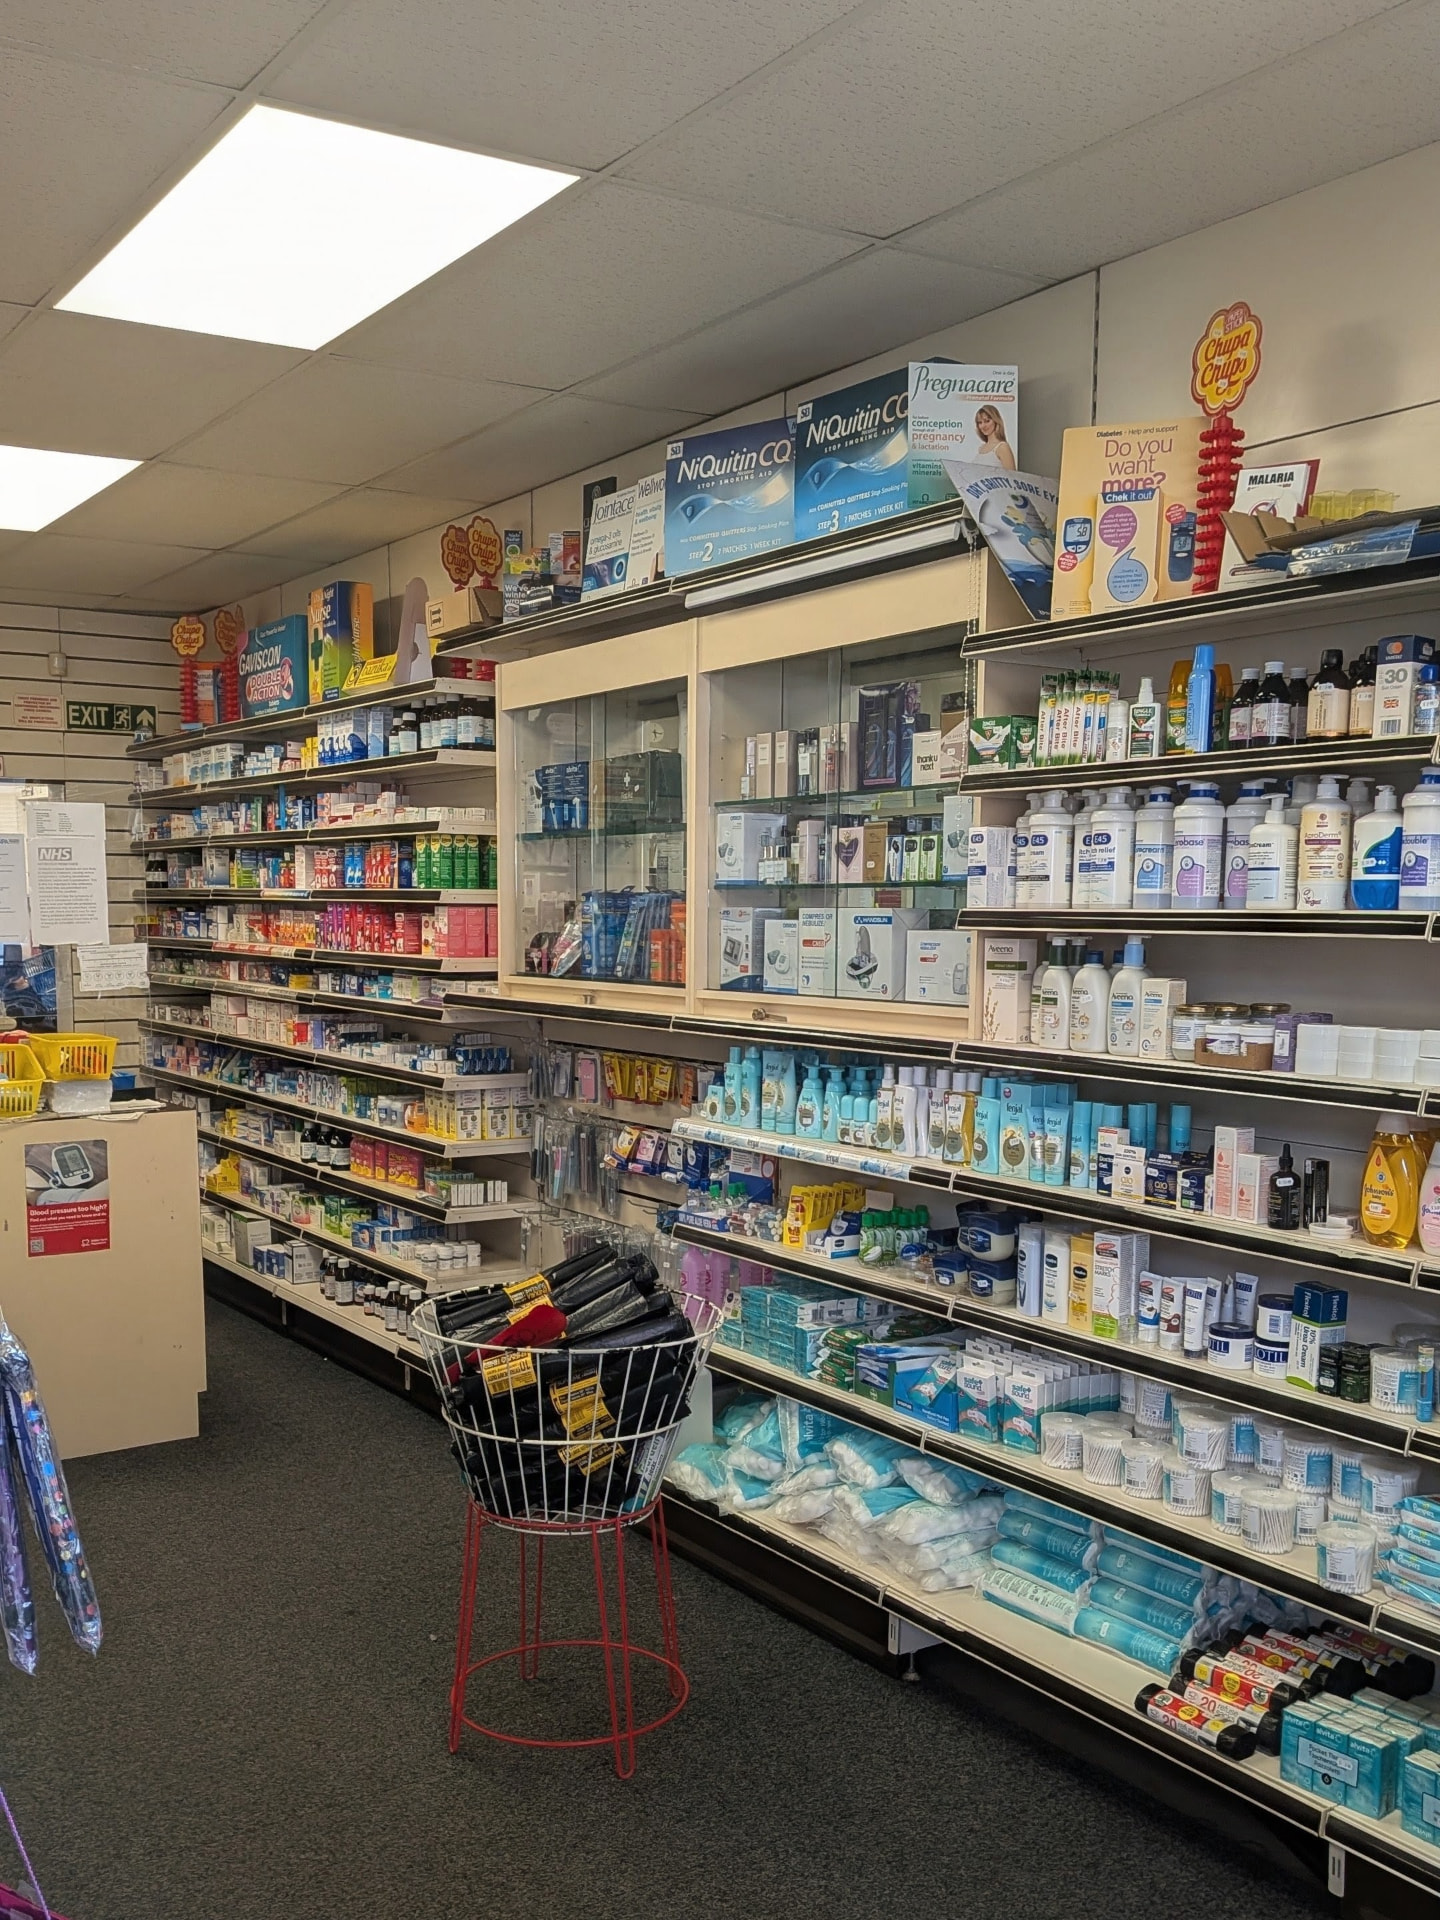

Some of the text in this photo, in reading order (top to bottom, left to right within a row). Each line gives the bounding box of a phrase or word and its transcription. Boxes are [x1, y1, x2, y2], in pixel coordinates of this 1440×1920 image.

[1205, 329, 1251, 362] Chupa
[1201, 356, 1248, 392] Chups
[911, 365, 1015, 400] Pregnacare
[806, 391, 908, 448] NiQuitin CQ
[912, 419, 962, 429] conception
[824, 426, 895, 453] STOP SMOKING AID
[912, 432, 965, 444] pregnancy
[1097, 425, 1179, 438] Diabetes Help and support
[1105, 438, 1173, 459] Do you
[677, 439, 792, 483] NiQuitin CQ
[1109, 455, 1155, 476] want
[697, 470, 773, 490] STOP SMOKING AID
[1102, 472, 1166, 493] more?
[1249, 472, 1294, 486] MALARIA
[1014, 479, 1041, 496] SORE
[818, 498, 845, 511] COMMITTED
[847, 491, 870, 503] QUITTERS
[1106, 490, 1153, 502] Chek it out
[593, 496, 634, 525] Jointace
[817, 521, 831, 531] STEP
[829, 509, 840, 532] 3
[844, 516, 848, 524] 7
[849, 511, 872, 523] PATCHES
[877, 503, 894, 515] WEEK
[894, 501, 905, 511] KIT
[472, 530, 498, 547] Chupa
[590, 531, 612, 545] omega-3
[689, 531, 719, 542] COMMITTED
[721, 526, 745, 537] QUITTERS
[471, 543, 497, 566] Chups
[593, 539, 623, 555] glucosamine
[688, 550, 704, 560] STEP
[701, 541, 714, 562] 2
[722, 543, 747, 555] PATCHES
[753, 540, 770, 550] WEEK
[771, 538, 782, 548] KIT
[310, 604, 331, 624] Nurse
[177, 624, 201, 635] Chupa
[175, 635, 200, 648] Chups
[239, 645, 282, 676] GAVISCON
[252, 668, 281, 685] DOUBLE
[1385, 668, 1408, 684] 30
[252, 685, 280, 700] ACTION
[68, 705, 109, 726] EXIT
[916, 755, 938, 764] thank u
[920, 762, 935, 772] next
[1031, 835, 1045, 846] E45
[1094, 834, 1107, 844] E45
[38, 848, 72, 861] NHS
[1099, 846, 1116, 854] relief
[988, 945, 1013, 954] Aveeno
[1112, 992, 1134, 1001] Aveeno
[1007, 1102, 1023, 1114] fenjal
[1047, 1117, 1062, 1127] fenjal
[1364, 1183, 1394, 1198] Johnson's
[50, 1207, 77, 1215] pressure
[90, 1204, 108, 1212] high?
[1331, 1295, 1339, 1321] Flexitol
[1309, 1329, 1317, 1345] 10%
[1300, 1345, 1309, 1368] Cream
[964, 1377, 978, 1385] safe
[964, 1383, 982, 1391] sound
[1012, 1384, 1027, 1392] safe
[1012, 1390, 1029, 1399] sound
[1413, 1502, 1434, 1518] Pampers
[1408, 1530, 1431, 1546] Pampers
[1398, 1554, 1420, 1571] Pampers
[1200, 1697, 1239, 1717] 20 refuse
[1162, 1714, 1198, 1739] 20 refuse
[1284, 1714, 1303, 1727] alvita
[1316, 1727, 1335, 1740] alvita
[1350, 1740, 1371, 1753] alvita
